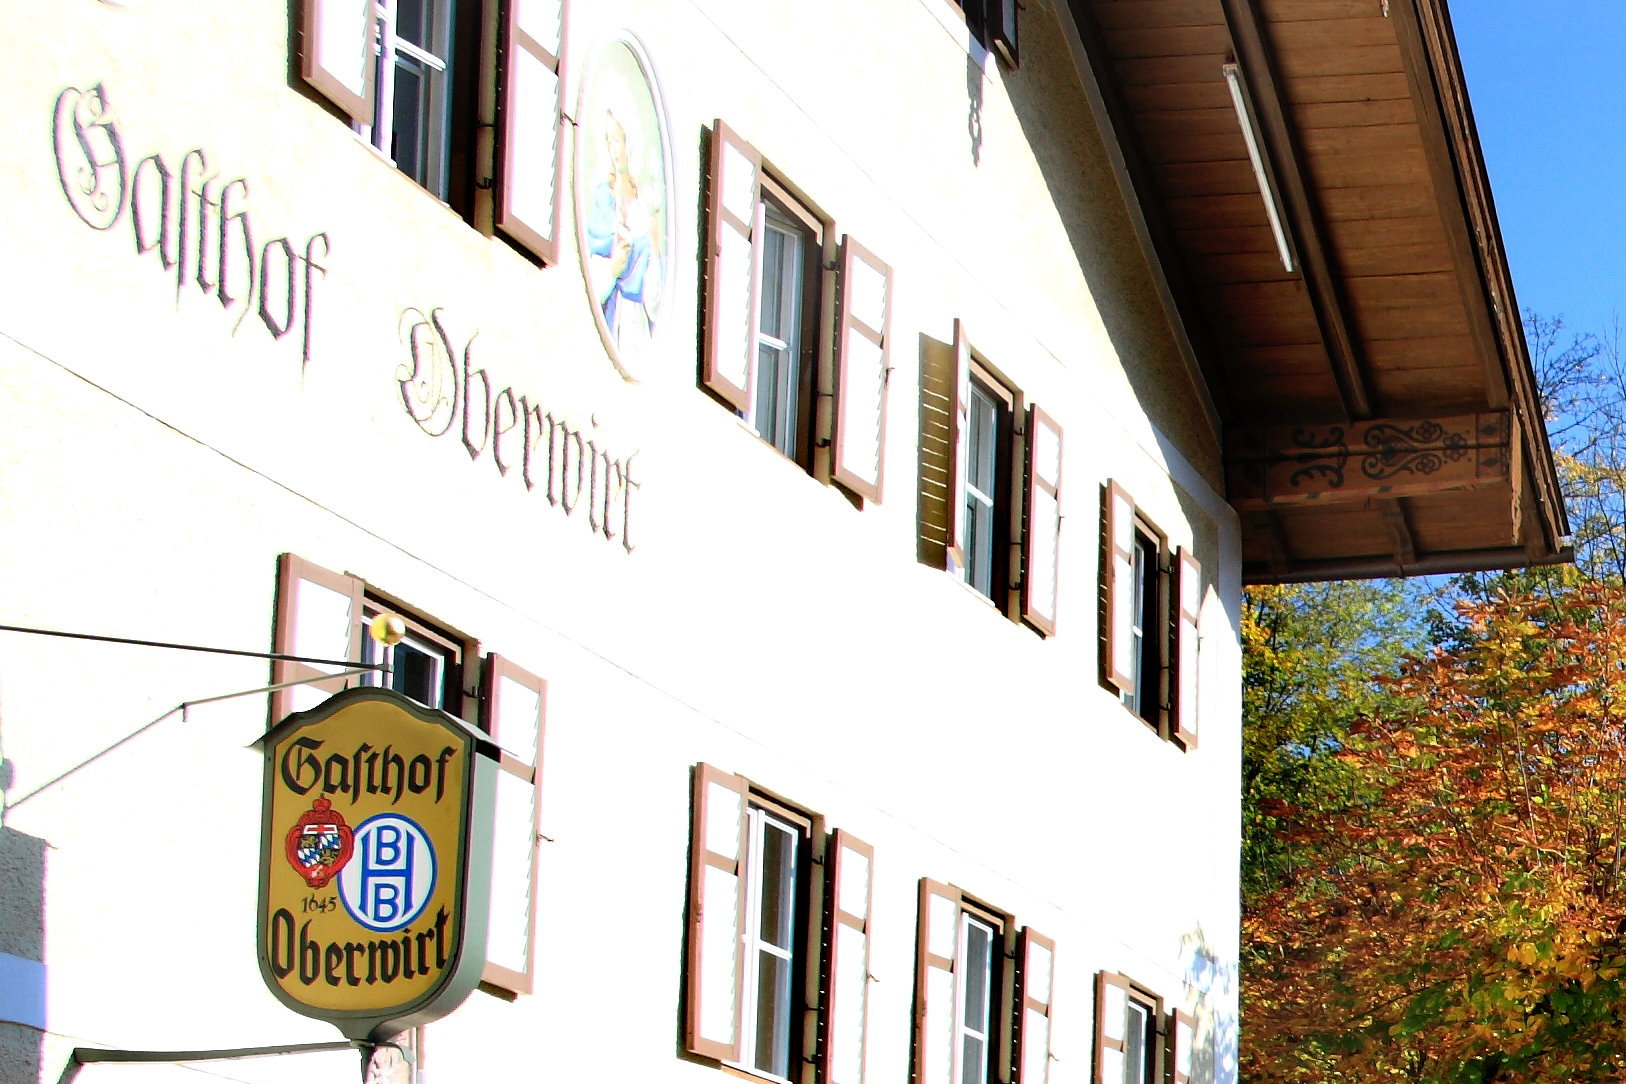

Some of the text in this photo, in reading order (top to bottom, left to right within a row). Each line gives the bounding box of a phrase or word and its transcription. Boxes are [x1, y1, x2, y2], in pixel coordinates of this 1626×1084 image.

[395, 306, 640, 554] Oberwirt
[301, 892, 337, 914] 1645
[271, 905, 450, 986] Oberwirt
